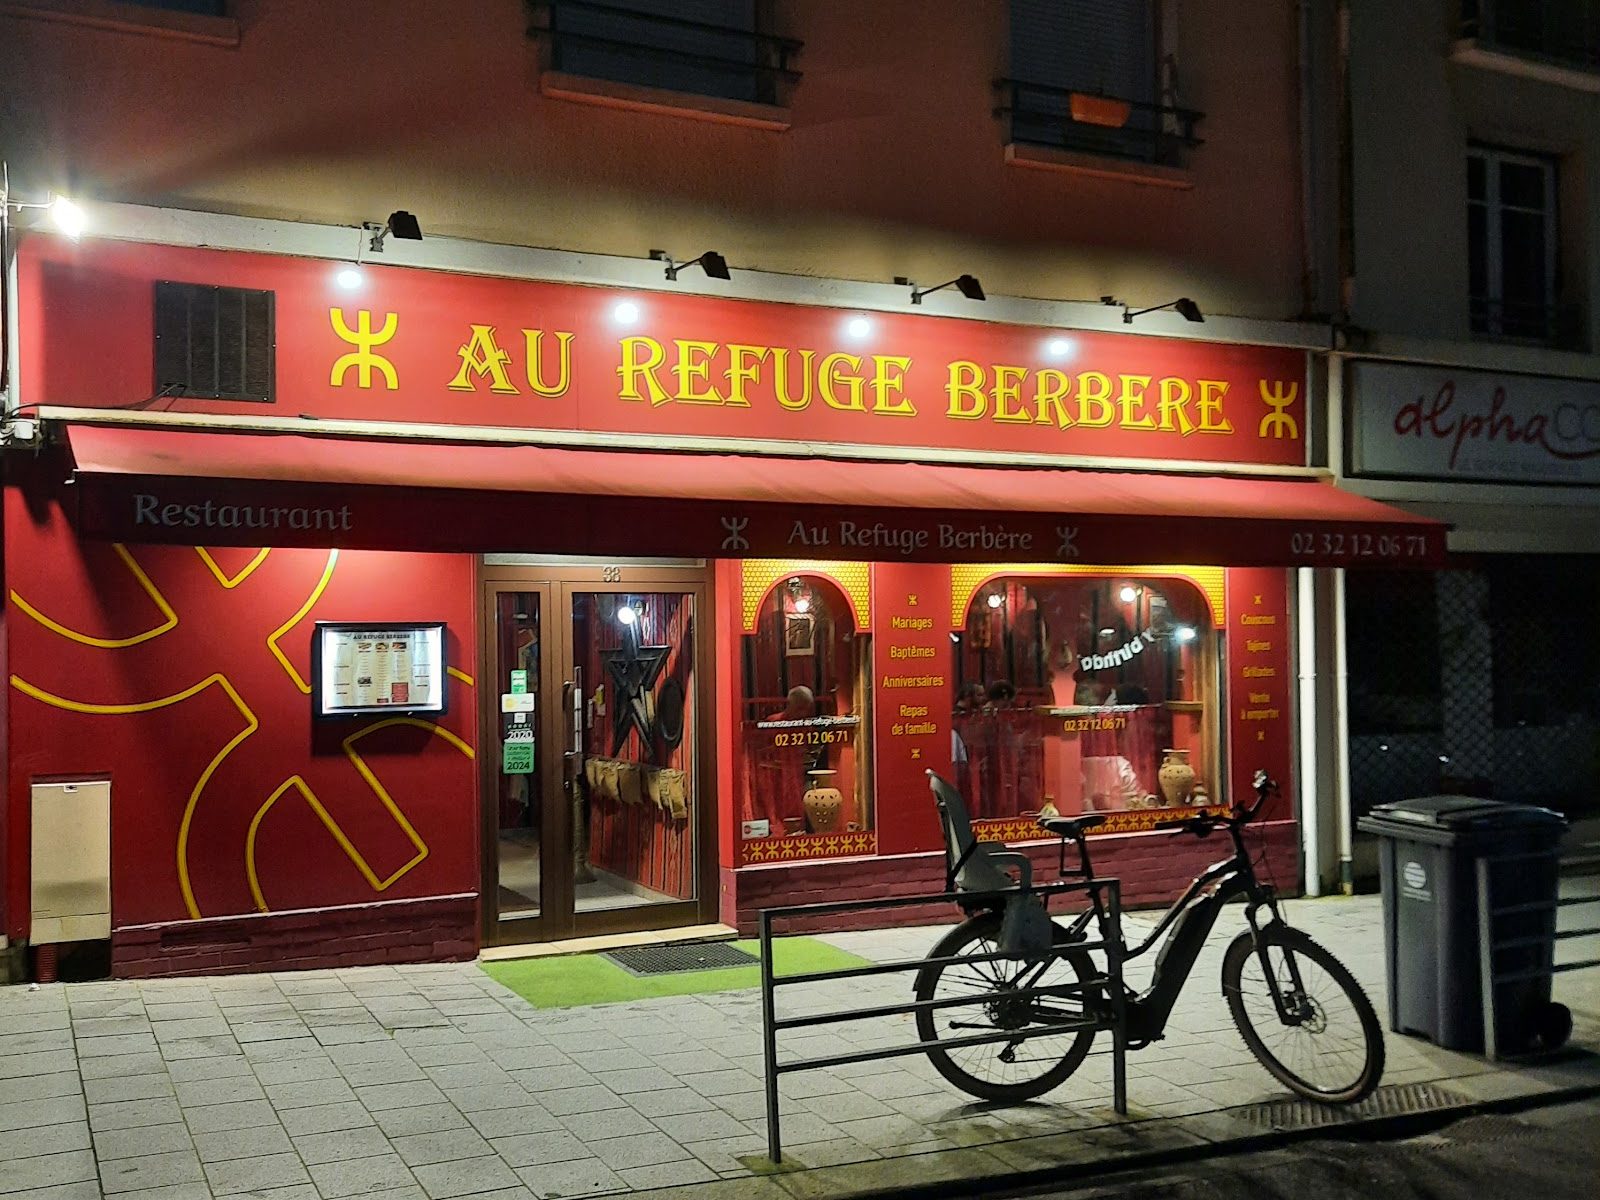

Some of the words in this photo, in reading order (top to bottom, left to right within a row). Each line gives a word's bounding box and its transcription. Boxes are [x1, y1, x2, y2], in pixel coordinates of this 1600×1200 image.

[447, 323, 575, 399] AU
[616, 335, 919, 418] REFUGE
[944, 360, 1235, 438] BERBERE
[133, 493, 353, 531] Restaurant
[787, 520, 830, 546] Au
[839, 520, 930, 554] Refuge
[938, 523, 1034, 551] Berbère
[1291, 532, 1316, 555] 02
[1321, 533, 1346, 556] 32
[1351, 534, 1374, 556] 12
[1379, 535, 1401, 557] 06
[1405, 535, 1427, 557] 71
[892, 616, 934, 631] Mariages
[890, 645, 936, 660] Baptêmes
[882, 674, 944, 688] Anniversaires
[899, 704, 928, 719] Repas
[507, 731, 533, 741] 2020
[891, 723, 904, 736] de
[905, 721, 937, 735] famille
[774, 733, 789, 747] 02
[790, 732, 804, 746] 32
[807, 732, 820, 745] 12
[821, 731, 835, 744] 06
[836, 730, 848, 743] 71
[506, 761, 530, 770] 2024
